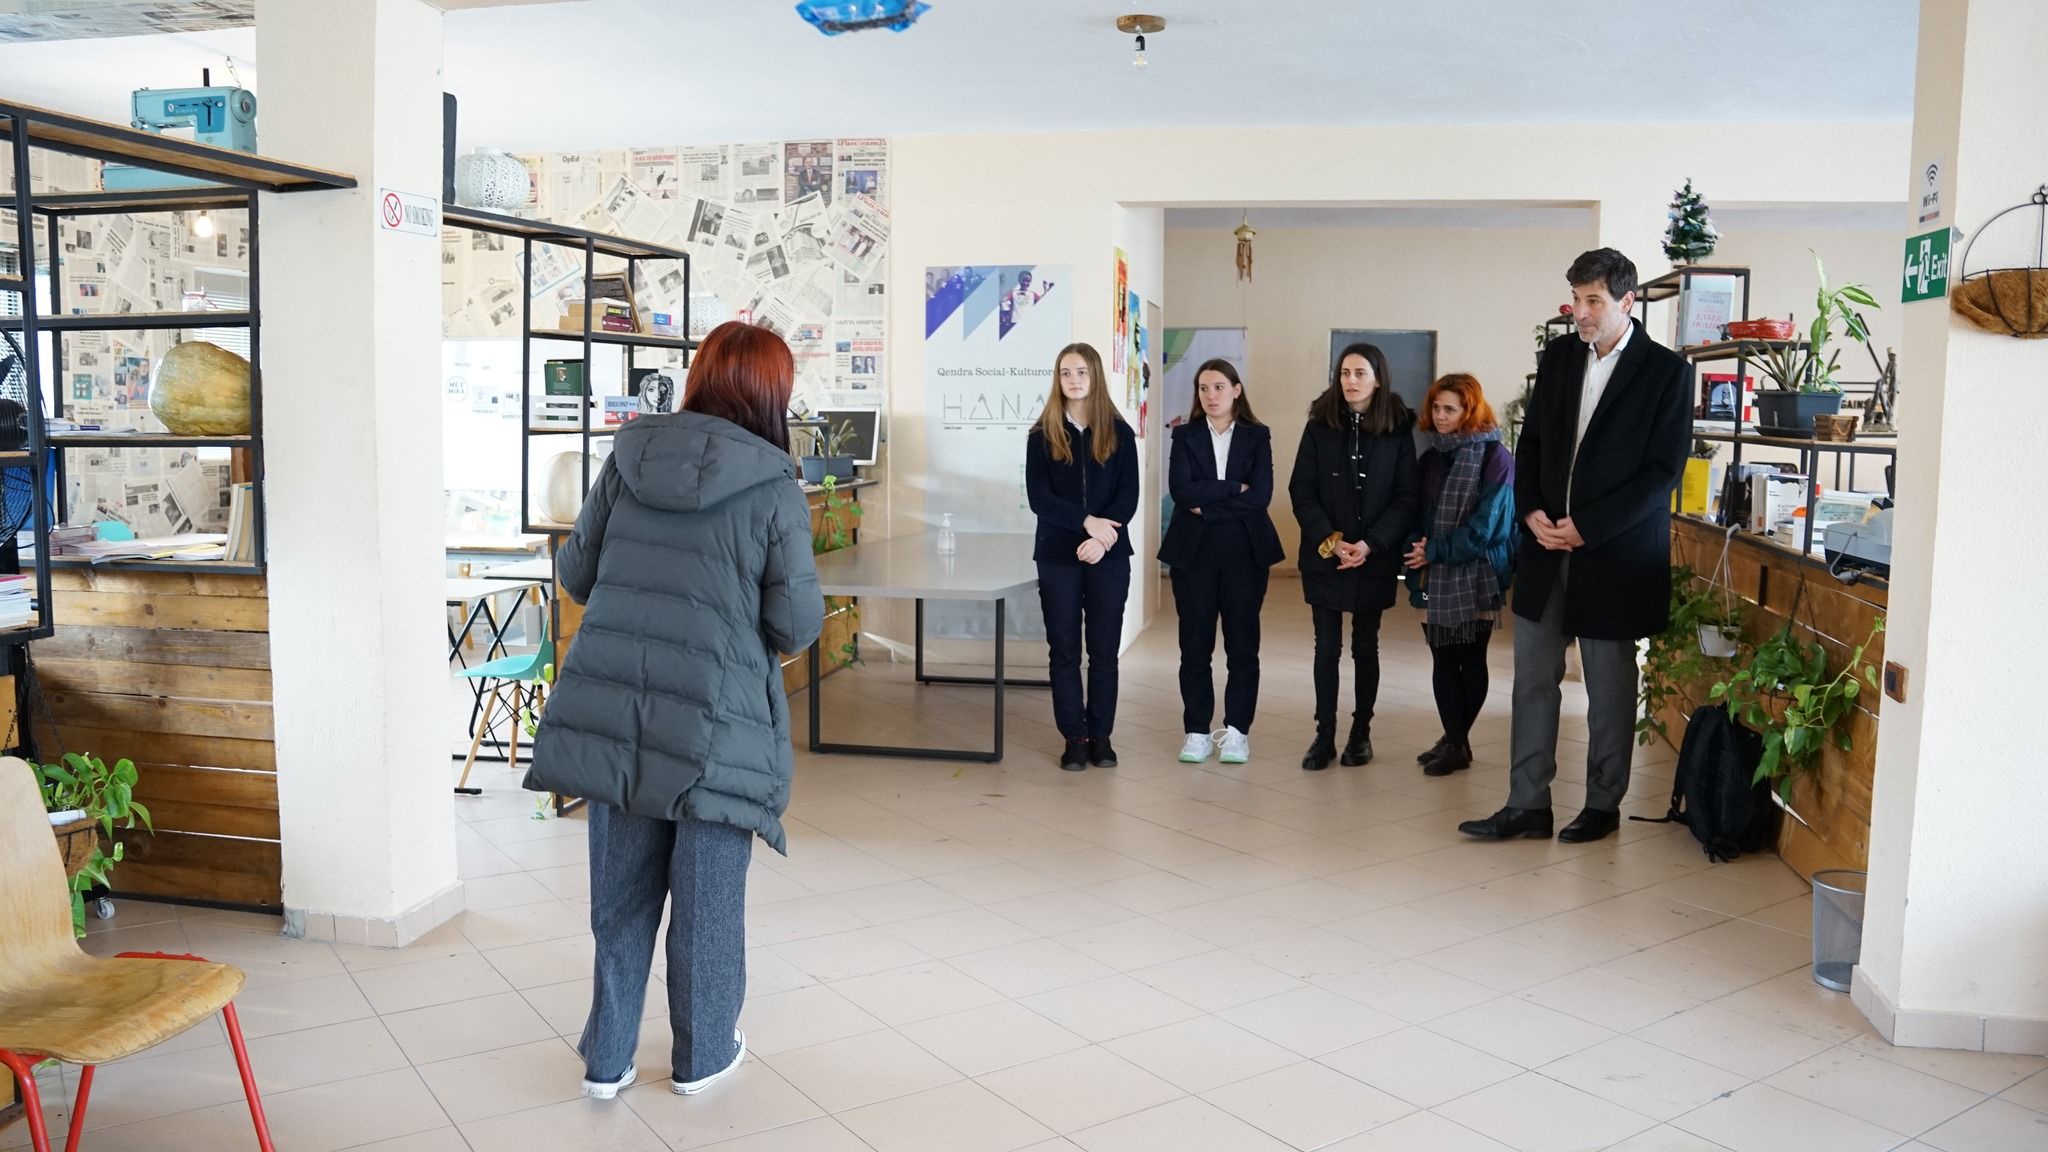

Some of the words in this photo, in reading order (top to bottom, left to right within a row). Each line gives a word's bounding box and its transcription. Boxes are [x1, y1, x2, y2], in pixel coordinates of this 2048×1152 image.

[562, 155, 580, 163] OpEd
[1923, 191, 1939, 207] Wi-Fi
[404, 204, 411, 223] NO
[412, 206, 433, 227] SMOKING
[1930, 252, 1947, 280] Exit
[937, 367, 973, 377] Qendra
[975, 367, 1055, 377] Social-Kulturor
